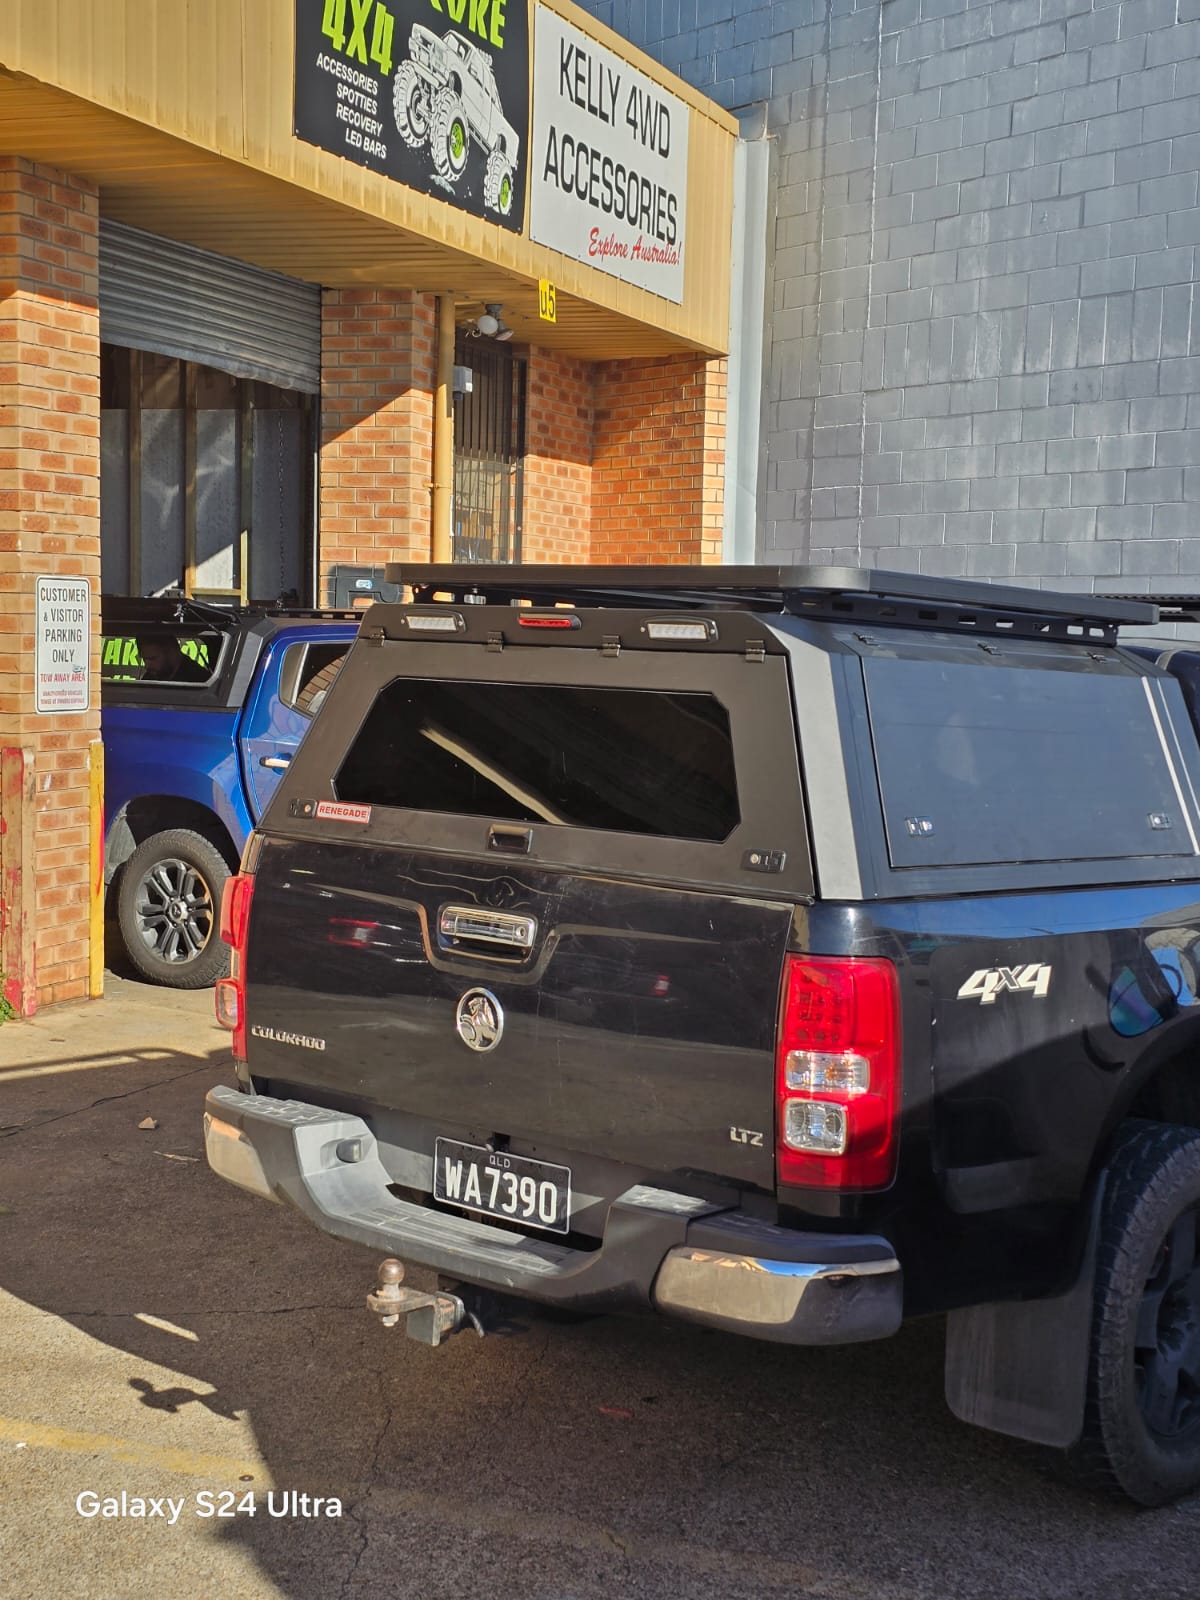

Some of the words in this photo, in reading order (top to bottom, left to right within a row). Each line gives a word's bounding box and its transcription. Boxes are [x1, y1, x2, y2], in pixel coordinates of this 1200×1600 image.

[315, 52, 379, 96] ACCESSORIES
[336, 82, 378, 116] SPOTTIES
[559, 36, 621, 127] KELLY
[626, 85, 671, 159] 4WD
[336, 102, 383, 138] RECOVERY
[345, 127, 363, 150] LED
[363, 138, 387, 160] BARS
[543, 125, 678, 246] ACCESSORIES
[588, 227, 628, 262] Explore
[631, 235, 682, 266] Australia!
[40, 587, 87, 602] CUSTOMER
[43, 611, 48, 621] &
[51, 608, 84, 623] VISITOR
[45, 629, 82, 642] PARKING
[52, 649, 75, 663] ONLY
[319, 805, 367, 818] RENEGADE
[251, 1024, 326, 1051] COLORADO
[730, 1127, 763, 1147] LTZ
[489, 1155, 511, 1168] QLD
[445, 1157, 558, 1224] WA7390
